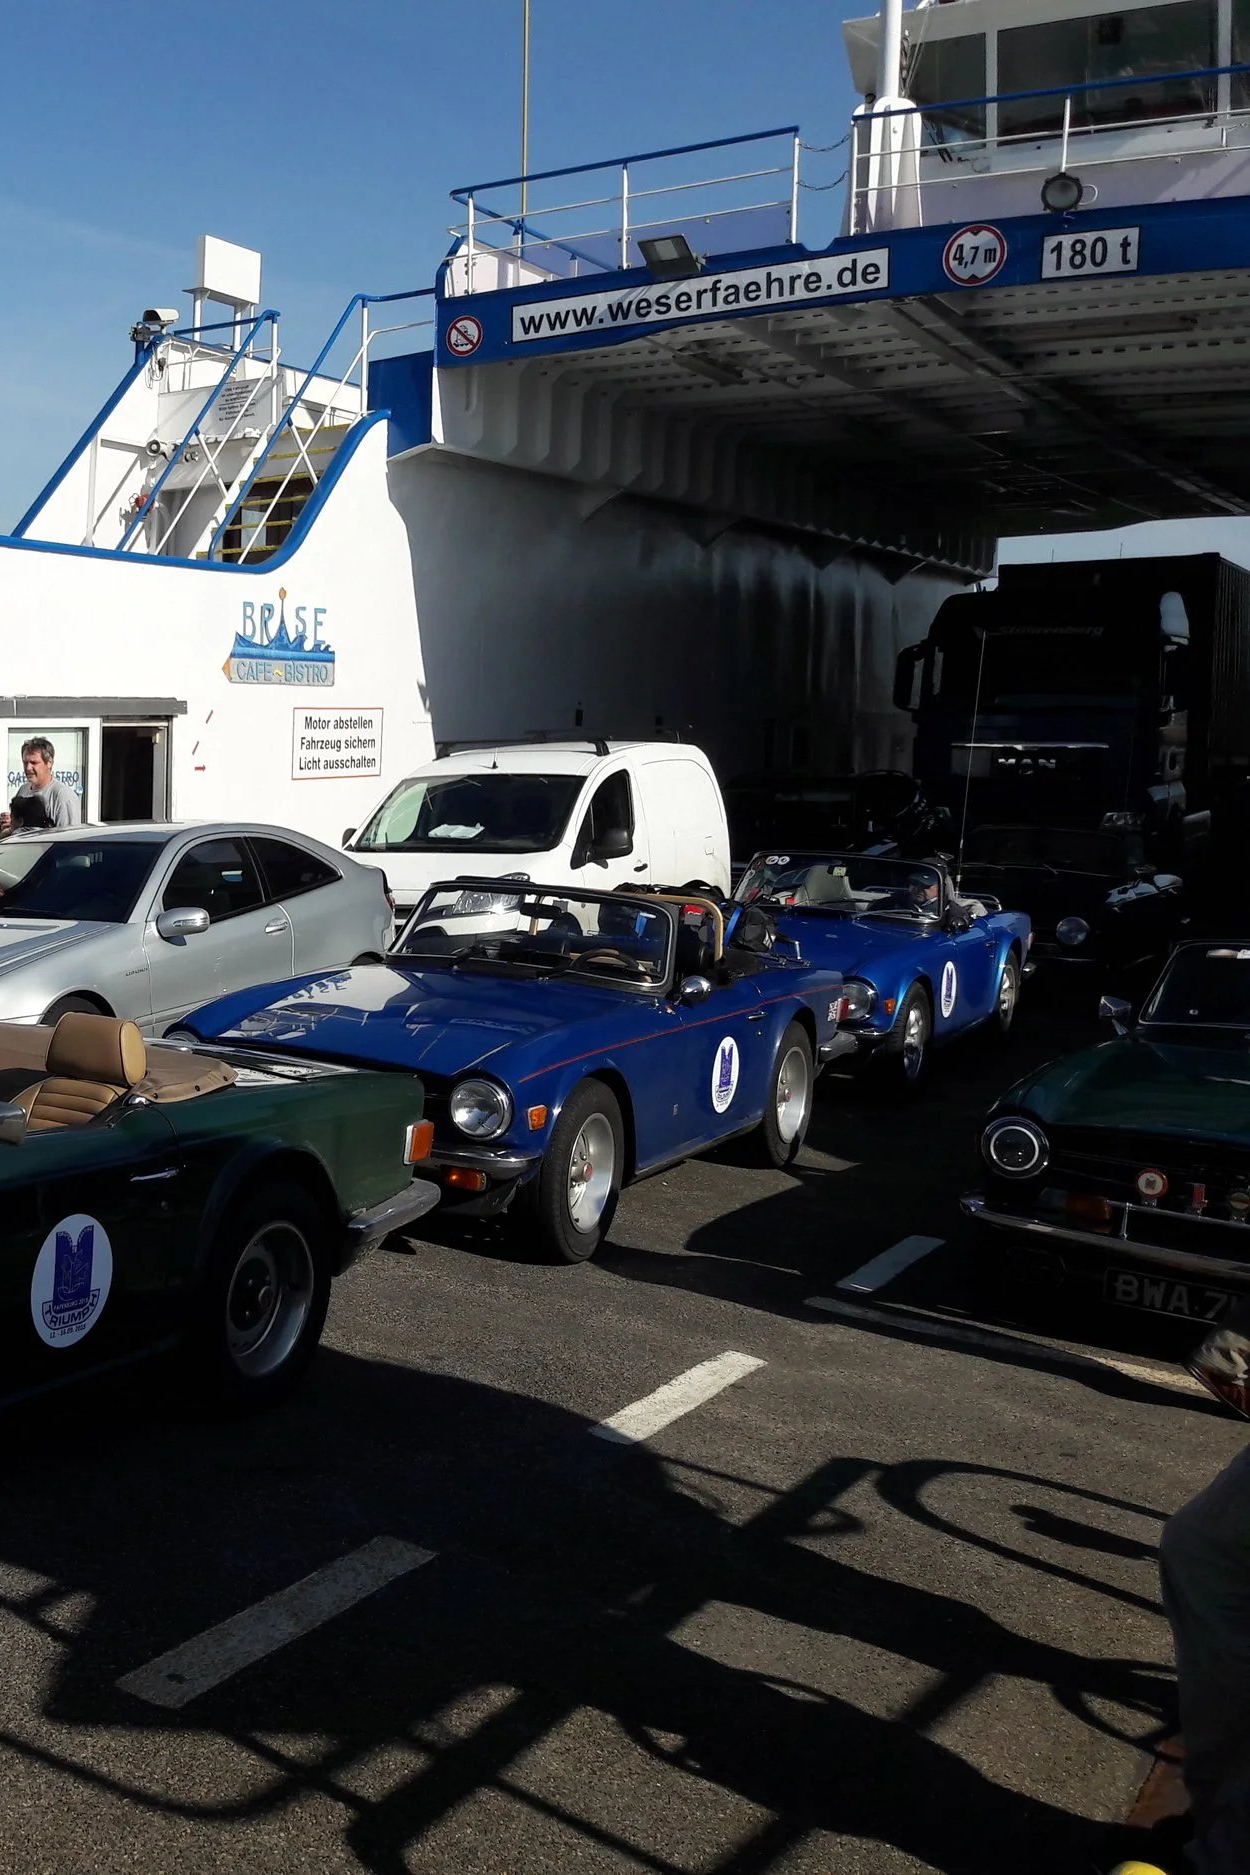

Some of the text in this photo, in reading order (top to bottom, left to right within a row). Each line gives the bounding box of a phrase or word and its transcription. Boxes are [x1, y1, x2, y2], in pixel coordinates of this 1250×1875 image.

[952, 243, 998, 269] 4,7 m
[1050, 235, 1132, 272] 180 t
[519, 258, 882, 336] www.weserfaehre.de
[236, 660, 328, 683] CAFE BISTRO
[304, 715, 373, 730] Motor abstellen
[300, 735, 376, 752] Fahrzeug sichern
[299, 755, 376, 770] Licht ausschalten
[44, 1293, 98, 1328] TRIUMPH
